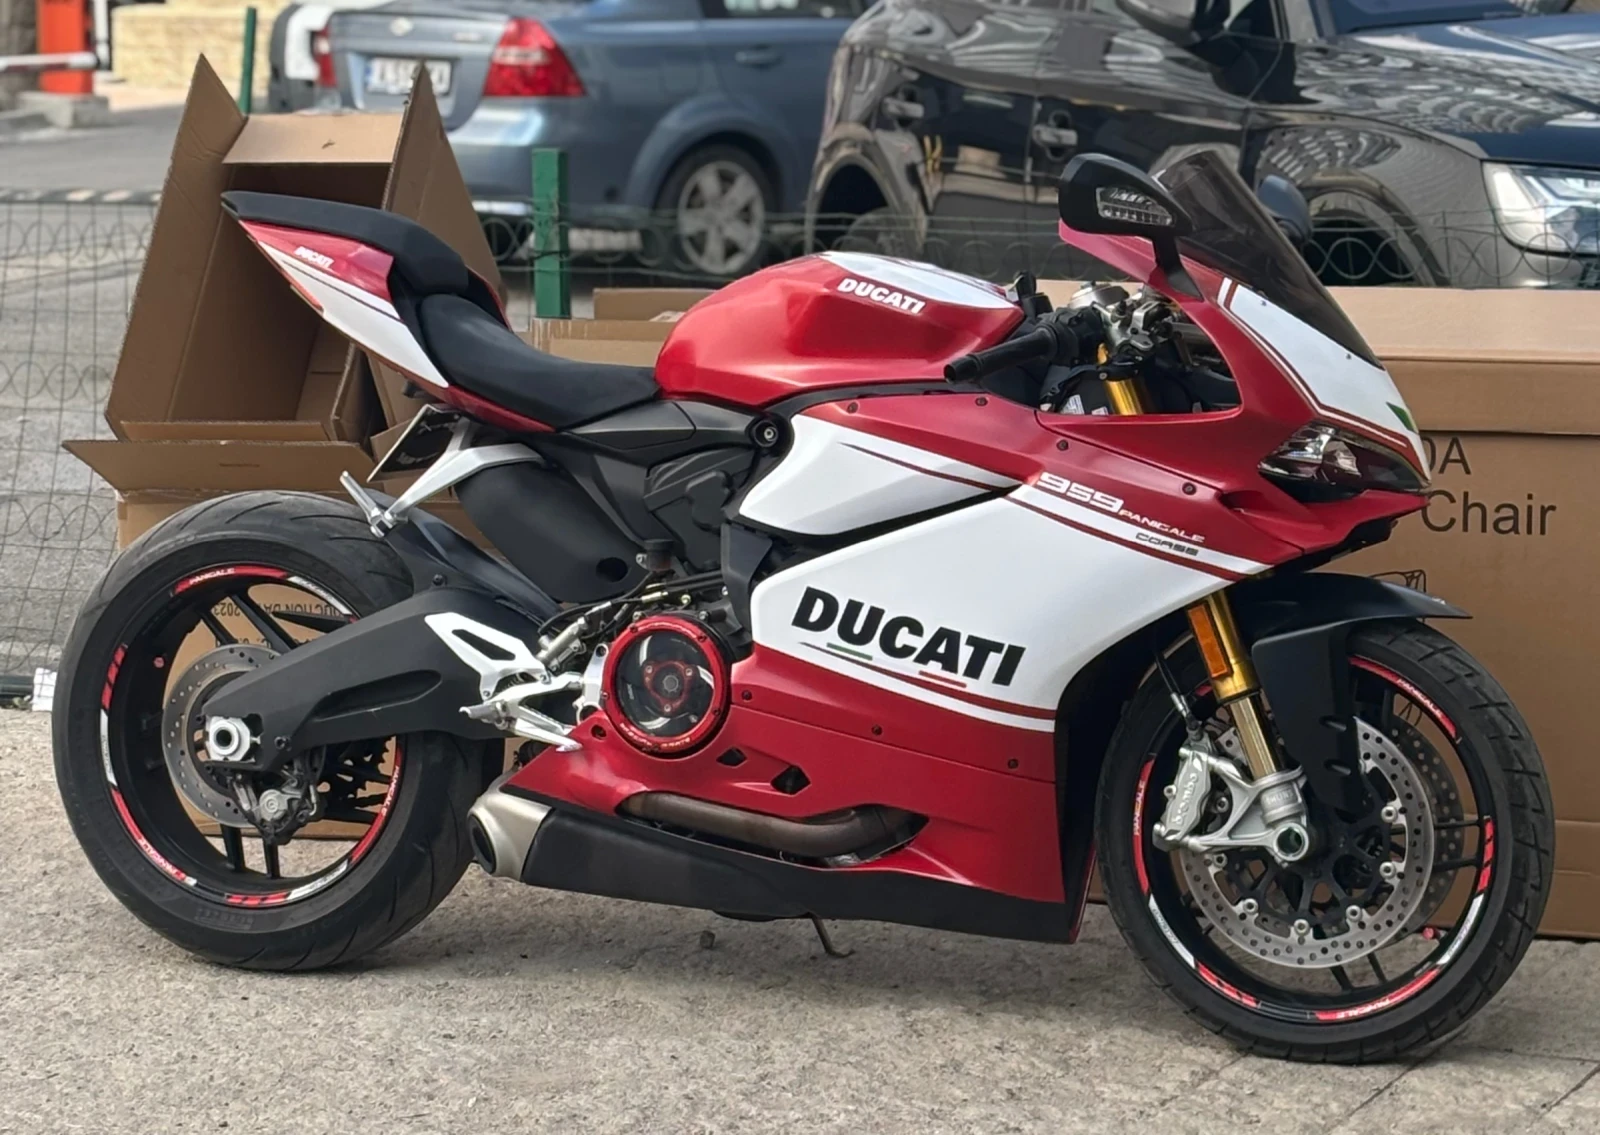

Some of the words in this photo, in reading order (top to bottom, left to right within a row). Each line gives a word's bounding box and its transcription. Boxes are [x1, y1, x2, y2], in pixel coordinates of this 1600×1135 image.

[837, 278, 926, 315] DUCATI
[1037, 471, 1125, 513] 959
[1118, 508, 1206, 543] PANIGALE
[1421, 489, 1557, 536] Chair
[1135, 532, 1199, 557] CORSE
[791, 586, 1027, 687] DUCATI
